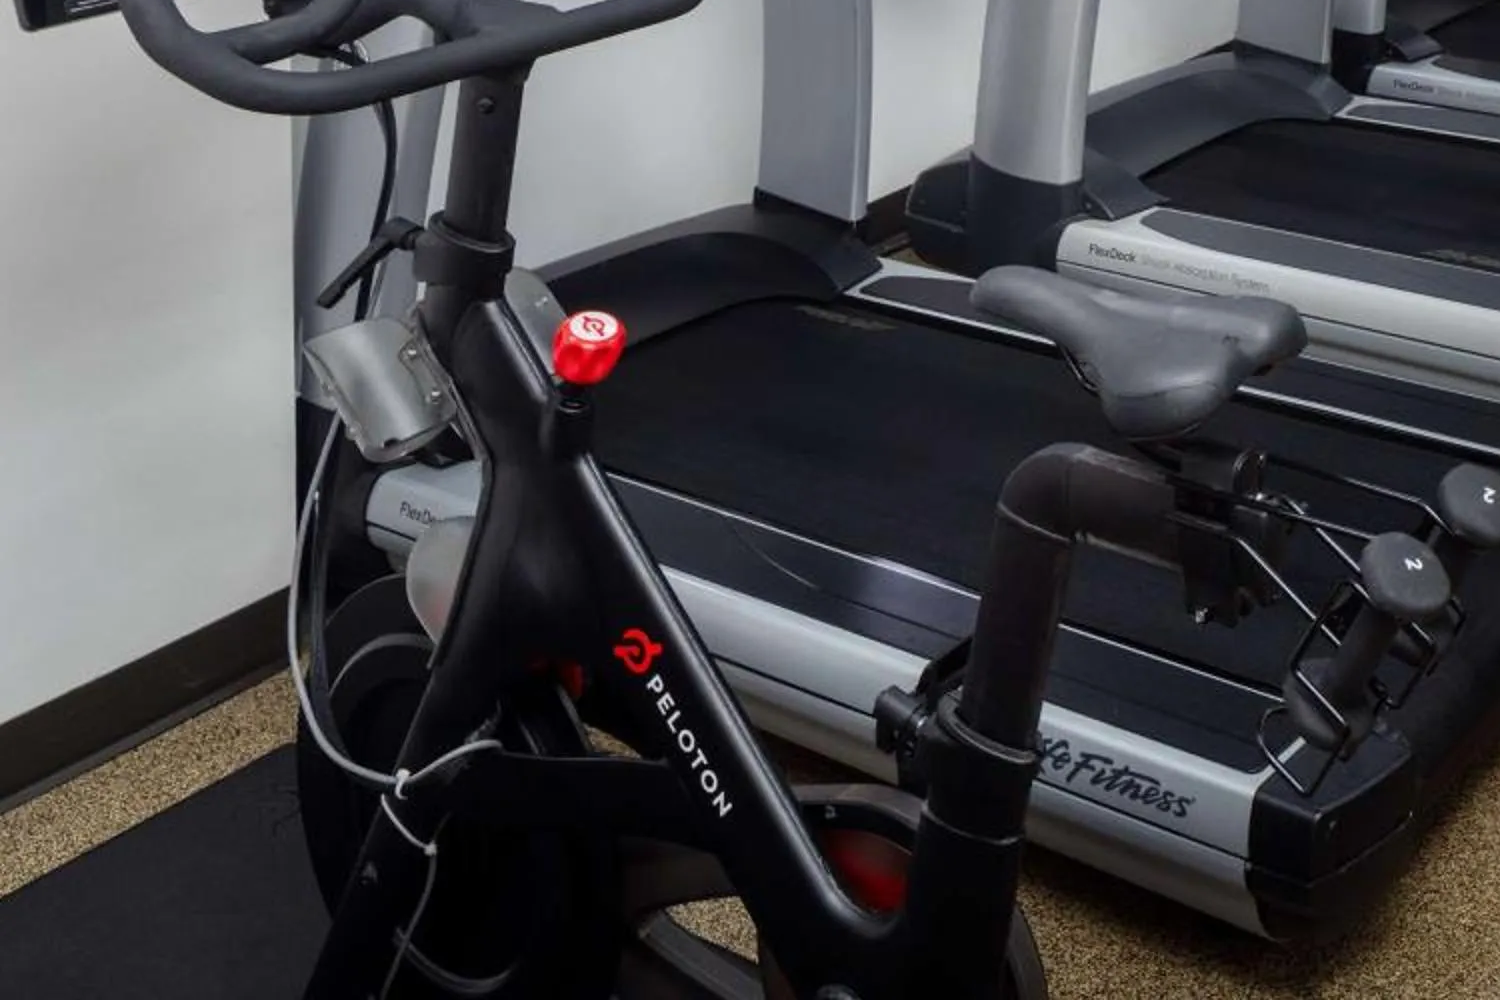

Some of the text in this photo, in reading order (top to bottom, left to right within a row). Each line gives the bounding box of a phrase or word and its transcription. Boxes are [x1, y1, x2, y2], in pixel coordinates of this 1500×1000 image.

[1482, 486, 1497, 505] 2
[1404, 557, 1424, 571] 2
[646, 674, 733, 818] PELOTON
[1065, 752, 1196, 818] Fitness
